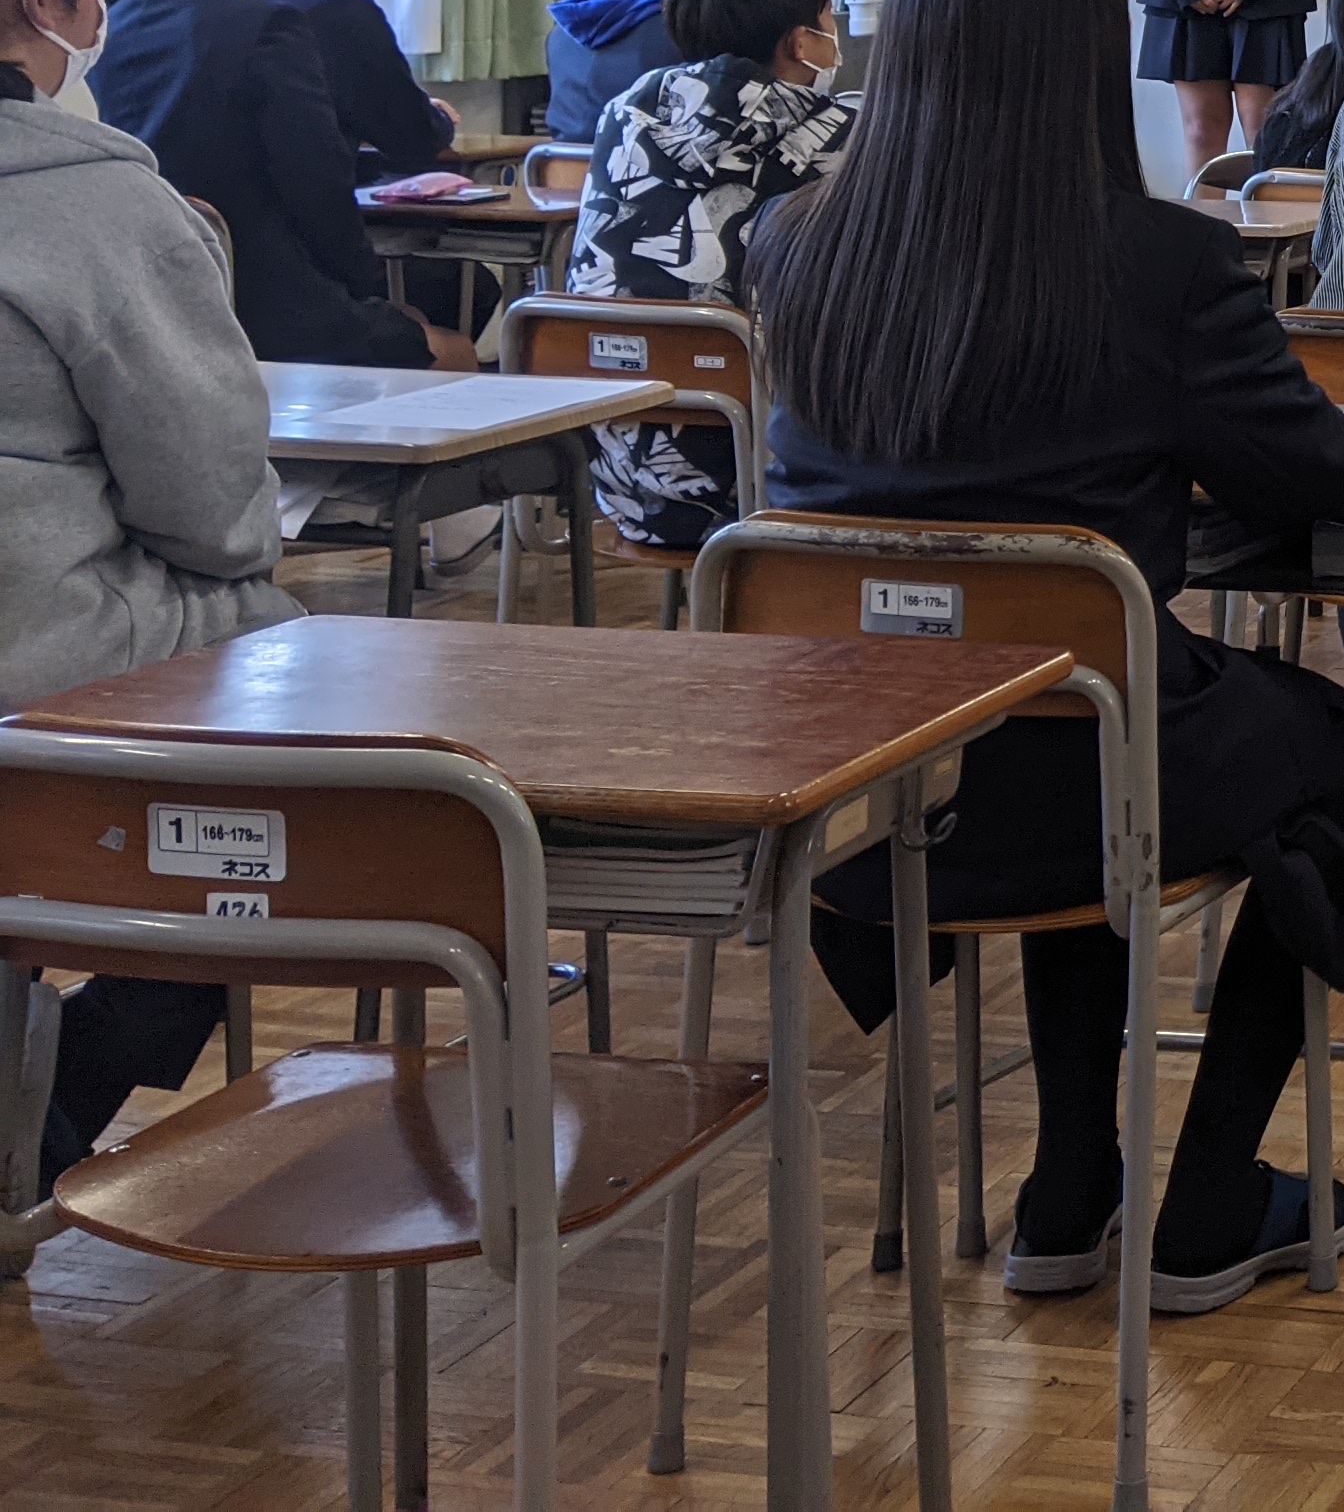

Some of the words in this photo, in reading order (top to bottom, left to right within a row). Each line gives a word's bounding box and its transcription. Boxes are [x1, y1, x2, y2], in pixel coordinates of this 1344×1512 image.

[598, 340, 604, 352] 1
[620, 360, 640, 370] ネコス
[878, 588, 888, 608] 1
[916, 622, 953, 636] ネコス
[168, 817, 182, 844] 1
[221, 859, 270, 878] ネコス
